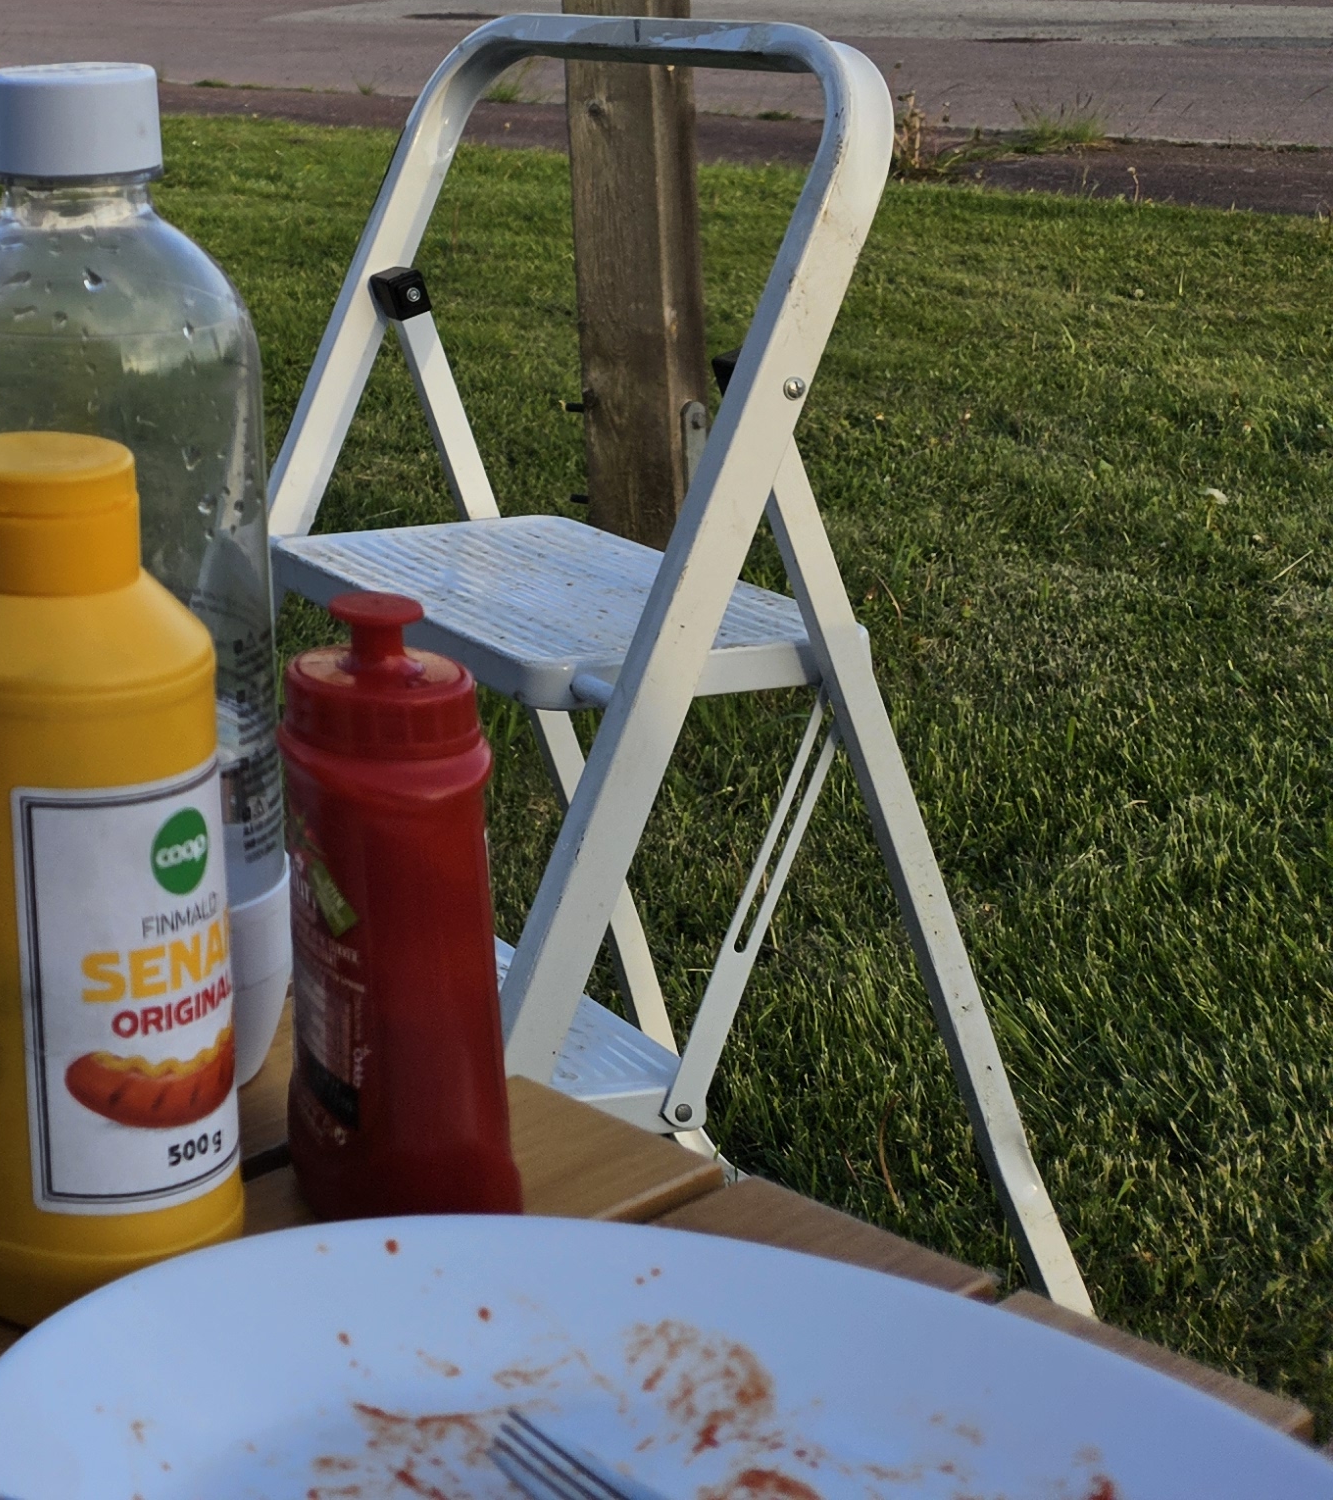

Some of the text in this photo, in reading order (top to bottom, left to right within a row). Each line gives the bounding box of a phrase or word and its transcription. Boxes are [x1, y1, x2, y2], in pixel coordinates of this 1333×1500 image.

[155, 834, 207, 869] coop
[80, 907, 229, 1004] SENA
[168, 1129, 223, 1168] 500 g
